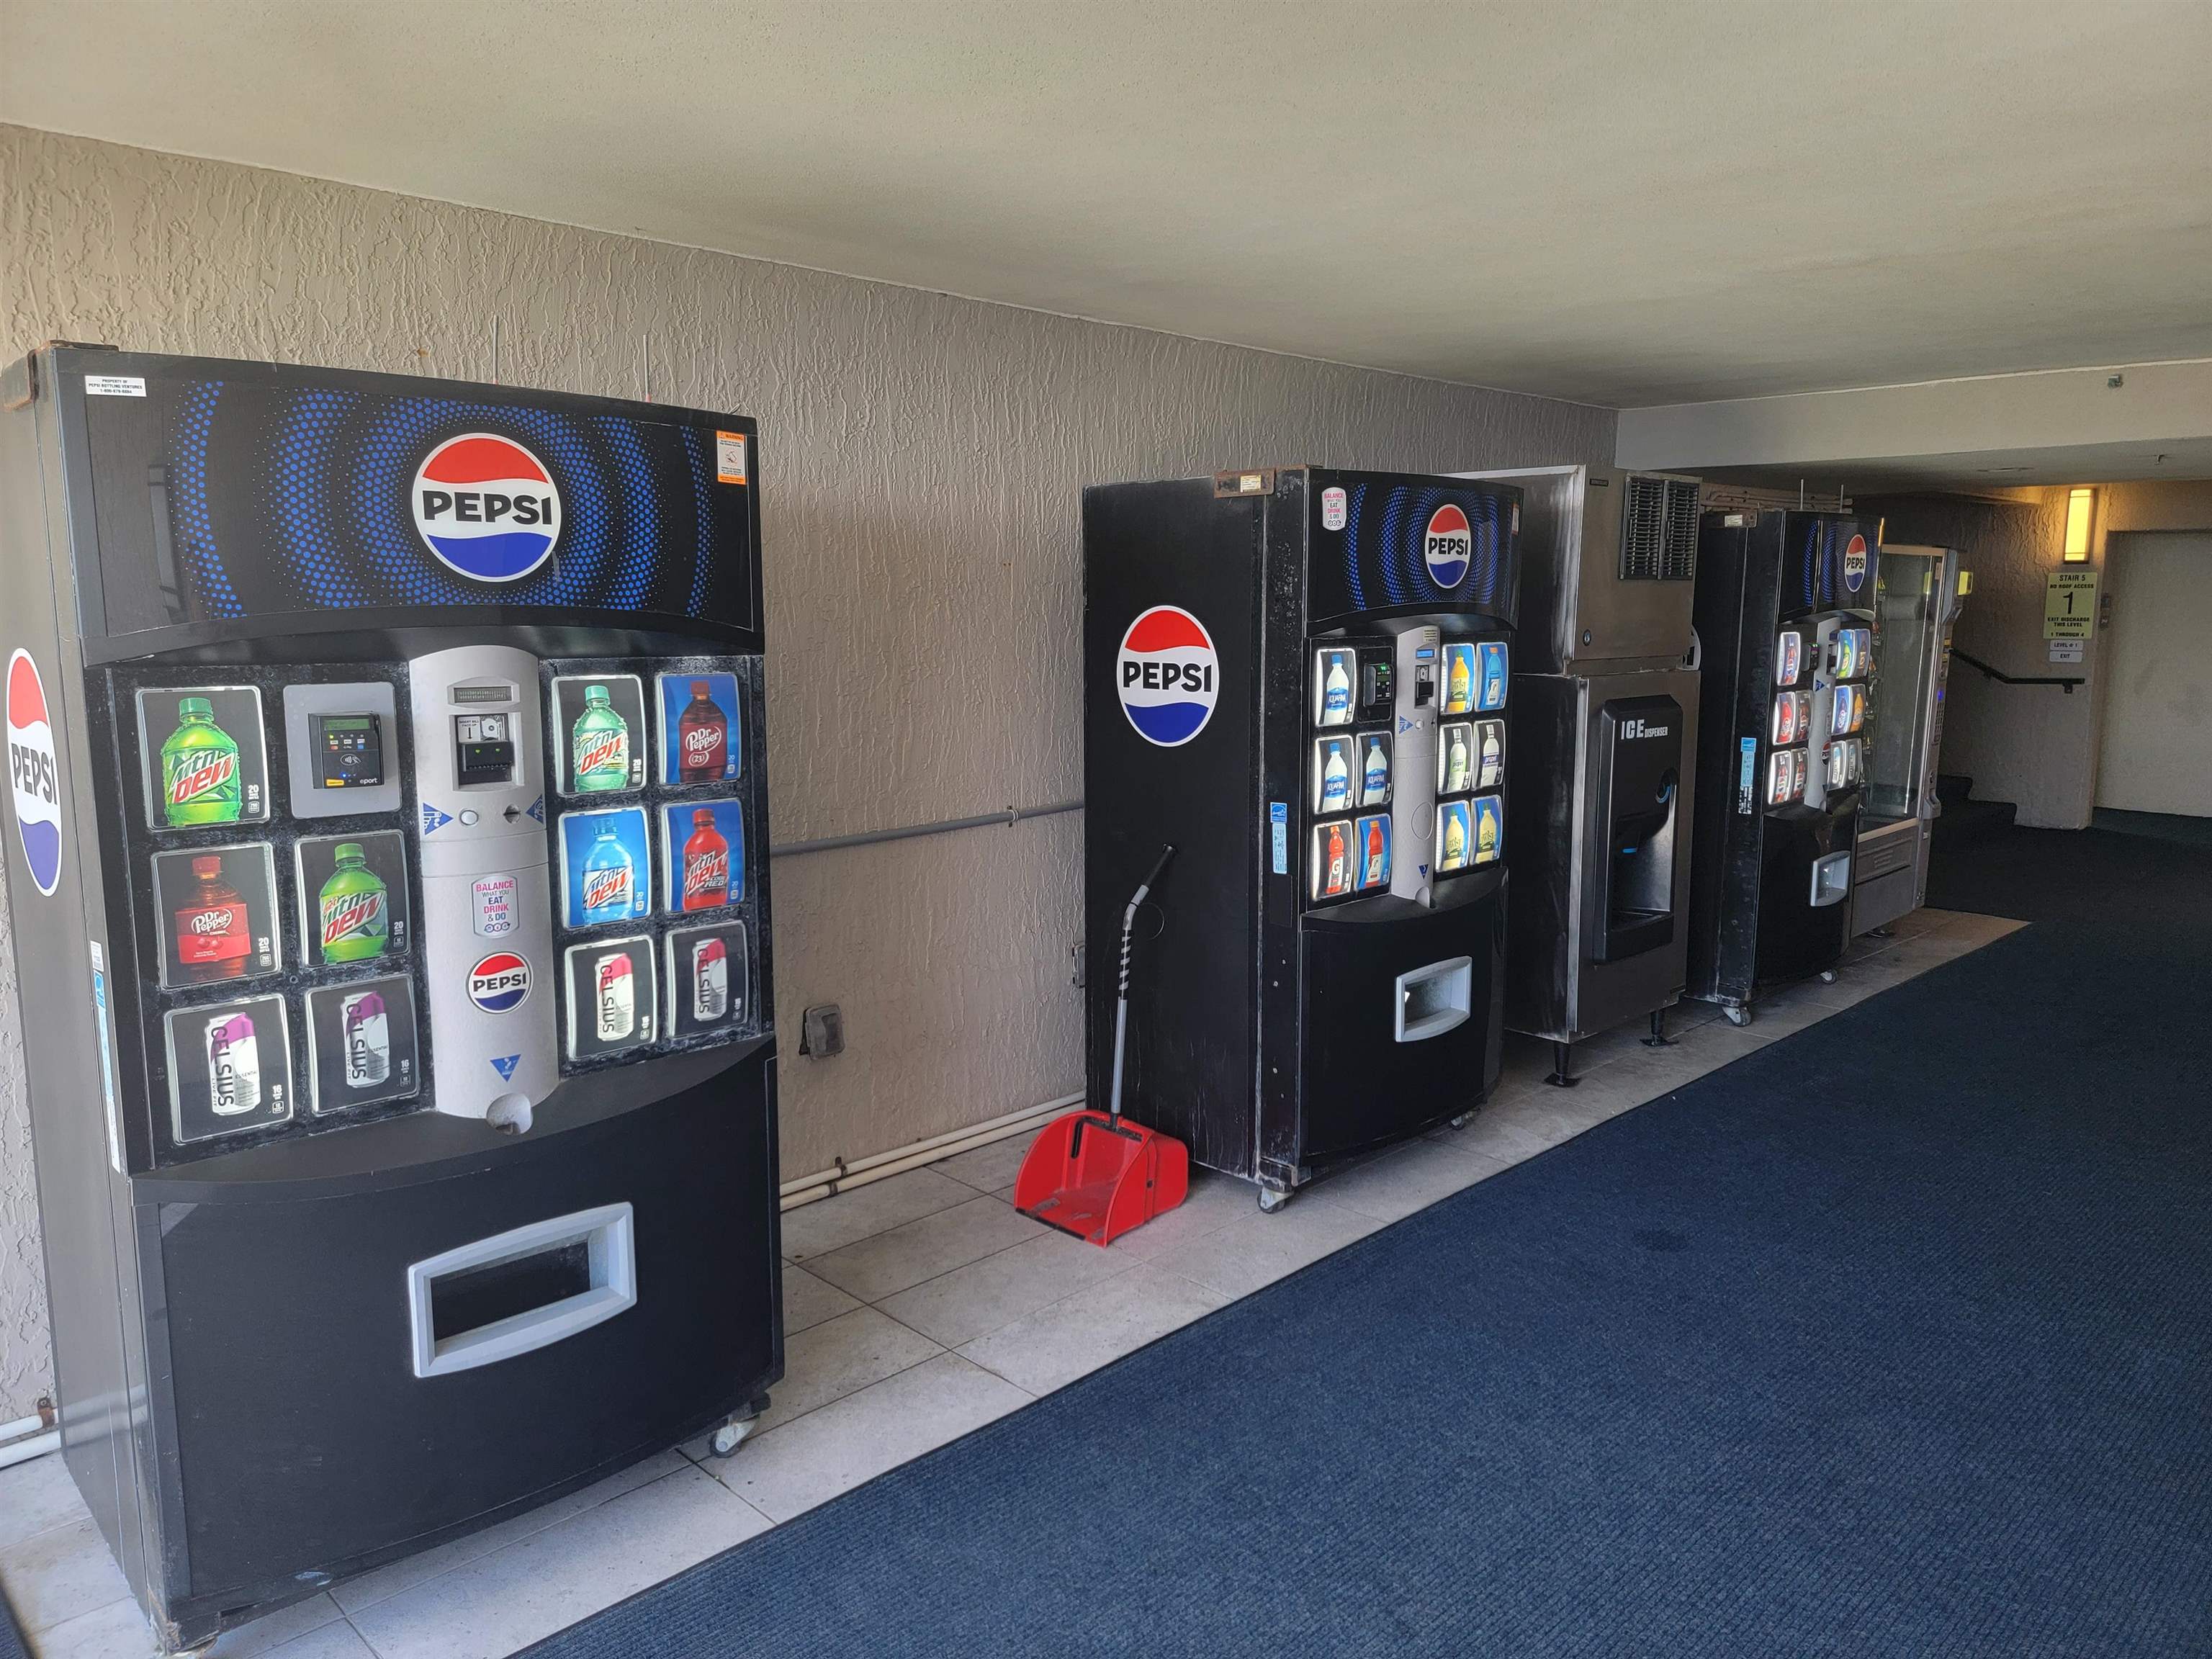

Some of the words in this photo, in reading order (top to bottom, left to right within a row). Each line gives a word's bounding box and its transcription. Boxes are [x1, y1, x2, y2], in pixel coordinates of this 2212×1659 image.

[423, 490, 552, 525] PEPSI
[1429, 537, 1468, 555] PEPSI
[1846, 557, 1865, 570] PEPSI
[2063, 592, 2073, 614] 1
[1123, 661, 1211, 692] PEPSI
[1328, 694, 1346, 703] AQUAFINA
[698, 728, 711, 740] Dr
[1621, 719, 1645, 739] ICE
[1645, 727, 1668, 738] DISPENSER
[685, 731, 719, 752] Pepper
[12, 742, 58, 805] PEPSI
[1367, 774, 1385, 785] AQUAFINA
[248, 784, 259, 793] 20
[1327, 781, 1345, 791] AQUAFINA
[1332, 859, 1340, 875] G
[476, 880, 514, 892] BALANCE
[488, 896, 503, 904] EAT
[484, 903, 508, 914] DRINK
[191, 912, 230, 934] Pepper
[204, 911, 220, 922] Dr
[495, 912, 506, 921] DO
[394, 921, 404, 930] 20
[258, 937, 269, 947] 20
[473, 973, 527, 992] PEPSI
[697, 948, 710, 1013] CELSIUS
[600, 965, 615, 1033] CELSIUS
[346, 1003, 367, 1079] CELSIUS
[211, 1026, 235, 1107] CELSIUS
[401, 1059, 410, 1068] 16
